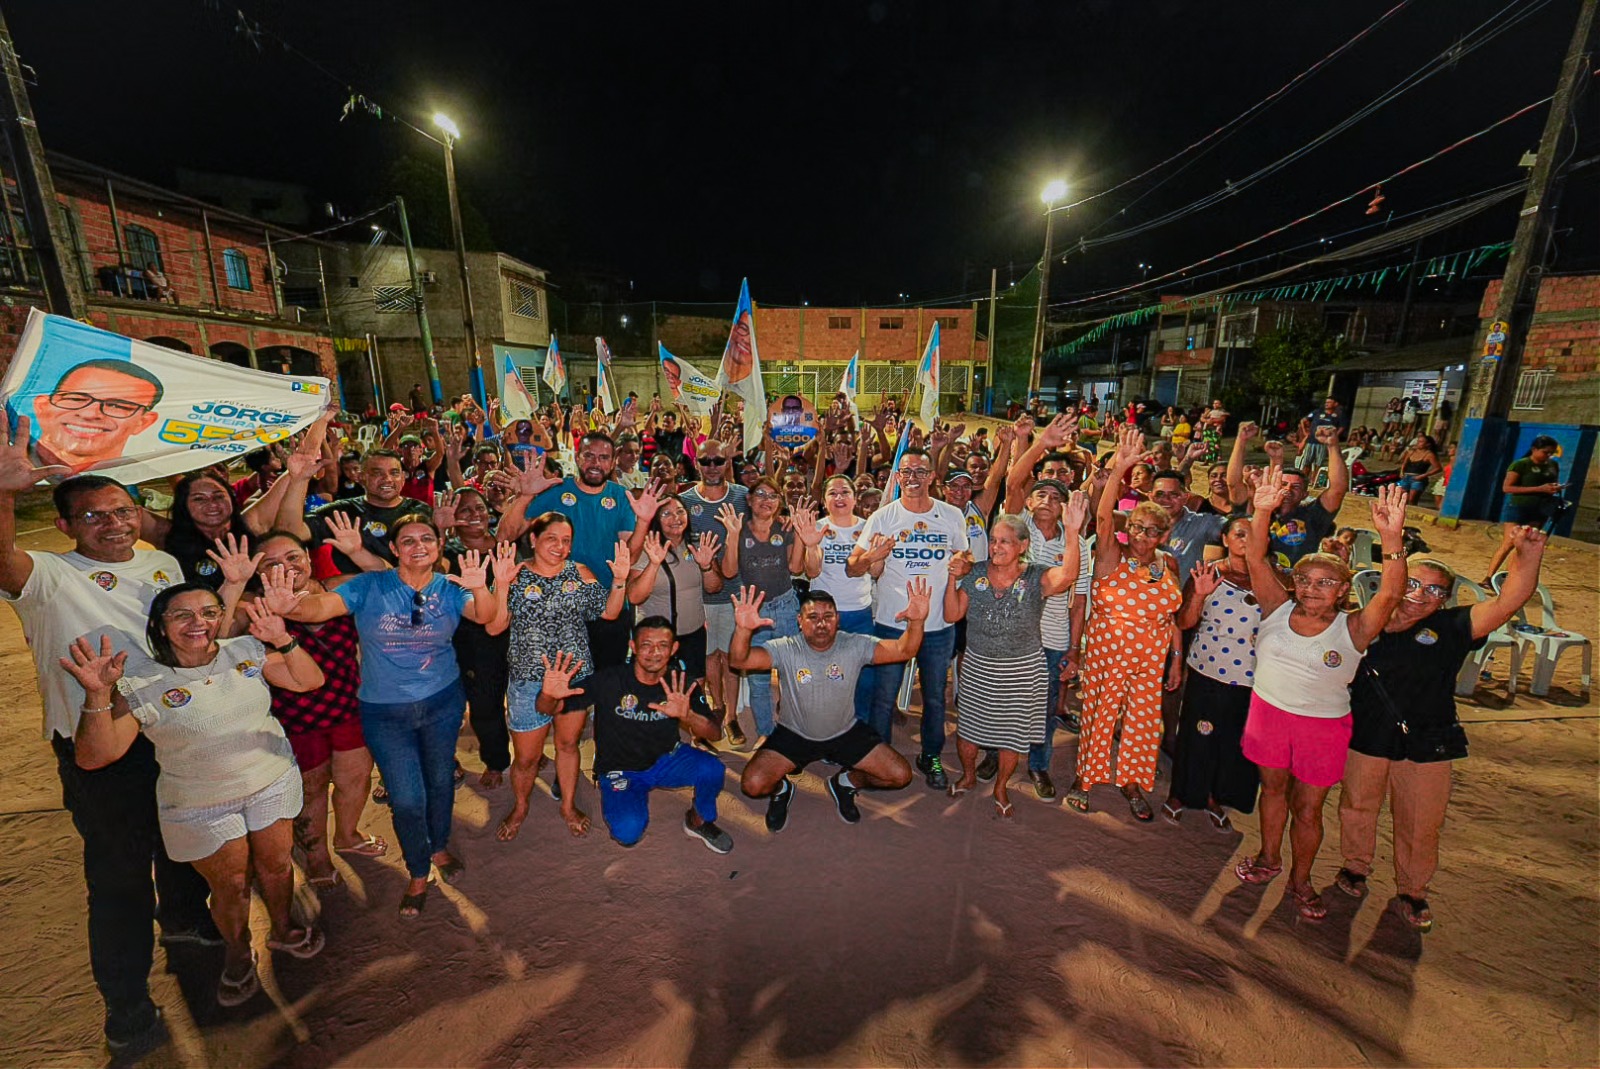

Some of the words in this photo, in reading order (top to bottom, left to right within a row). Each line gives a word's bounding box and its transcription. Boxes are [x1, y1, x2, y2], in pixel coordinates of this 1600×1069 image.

[291, 381, 320, 395] psd
[683, 382, 720, 398] 5500
[192, 401, 302, 425] JORGE
[187, 413, 256, 430] OLIVEIRA
[775, 435, 811, 443] 5500
[226, 443, 248, 453] 55
[891, 547, 946, 561] 5500
[615, 706, 649, 721] Calvin
